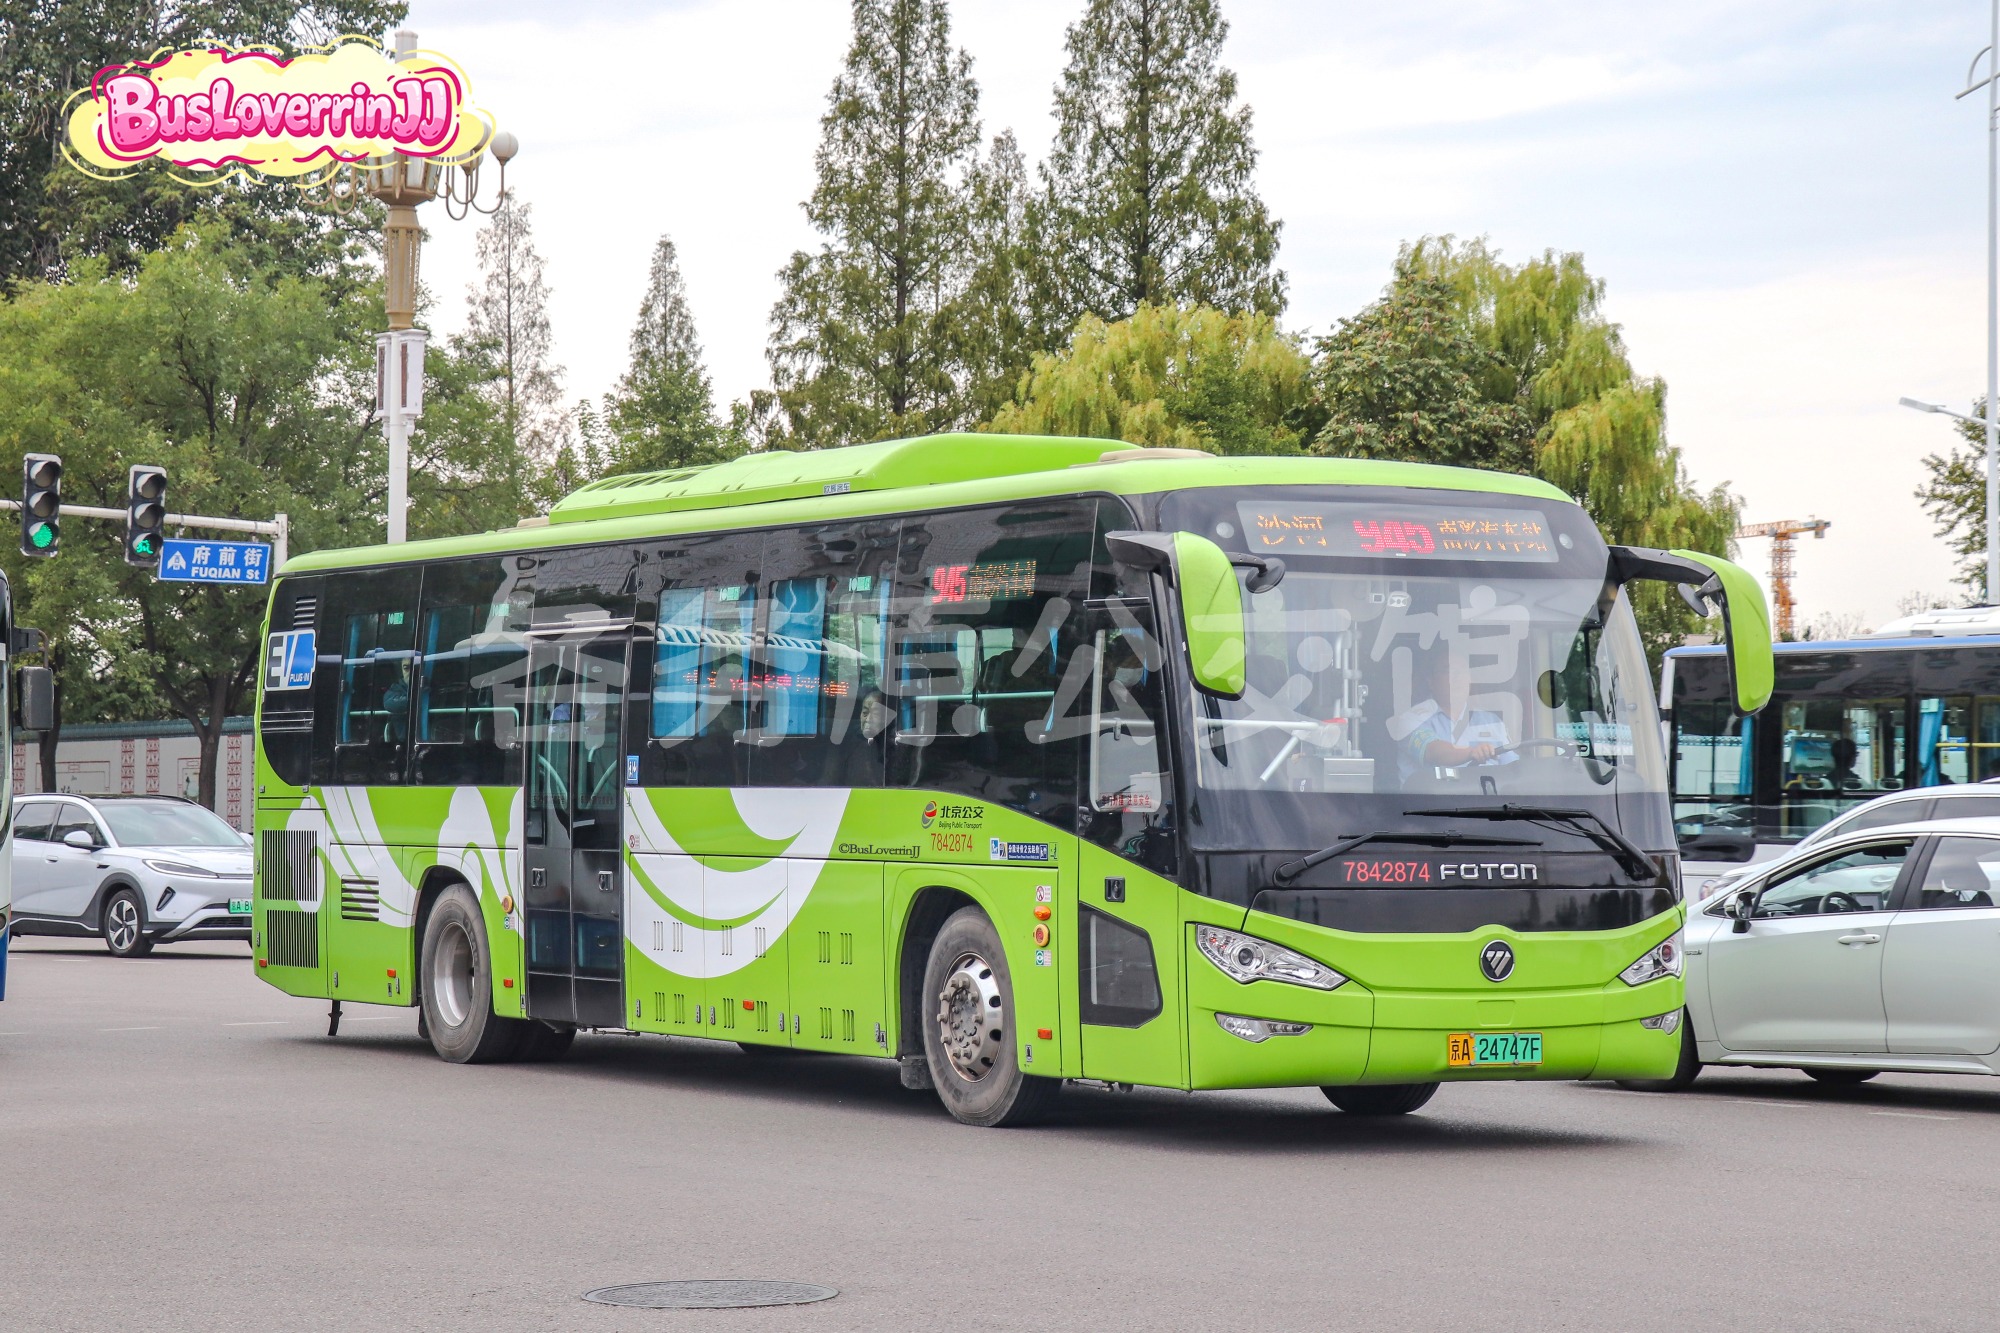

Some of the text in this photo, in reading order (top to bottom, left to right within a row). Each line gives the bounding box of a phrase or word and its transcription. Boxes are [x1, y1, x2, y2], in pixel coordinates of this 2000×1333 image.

[192, 545, 263, 567] 府前街
[191, 566, 260, 580] FUQIAN St
[932, 565, 969, 604] 945
[940, 806, 984, 819] 北京公交
[938, 820, 983, 830] Beijing Public Transport
[931, 833, 973, 852] 7842874
[1343, 861, 1539, 883] 7842874 FOTON
